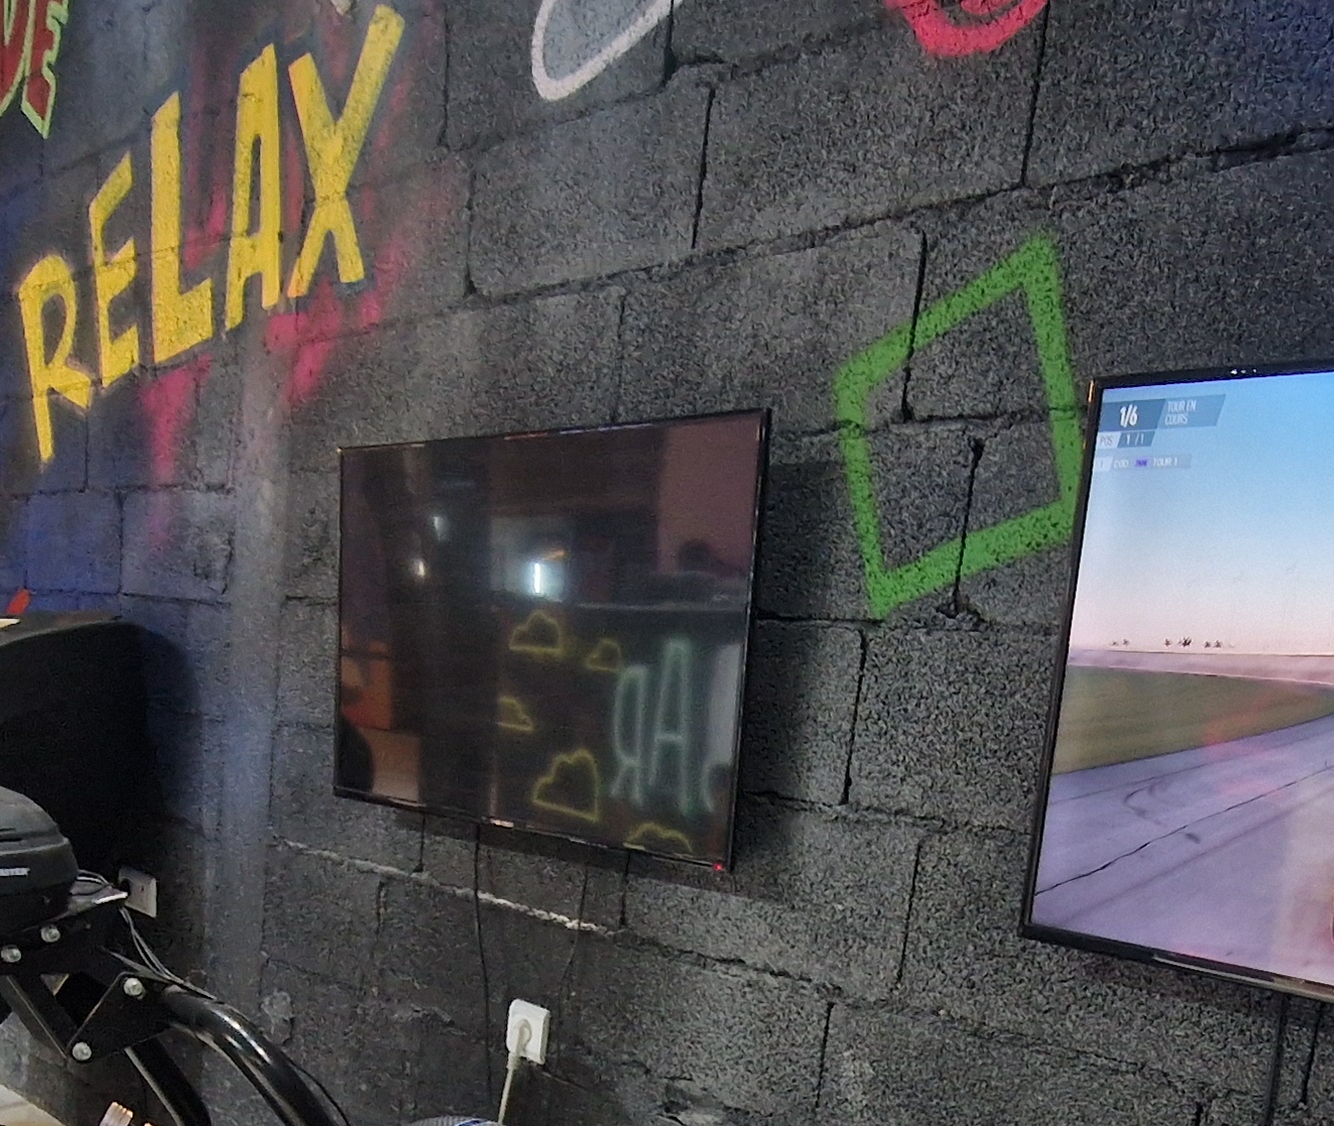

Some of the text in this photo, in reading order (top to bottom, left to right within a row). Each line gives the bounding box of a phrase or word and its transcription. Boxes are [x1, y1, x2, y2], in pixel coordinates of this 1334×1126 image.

[18, 5, 404, 463] RELAX
[1120, 403, 1138, 428] 1/6
[1167, 401, 1185, 412] TOUR
